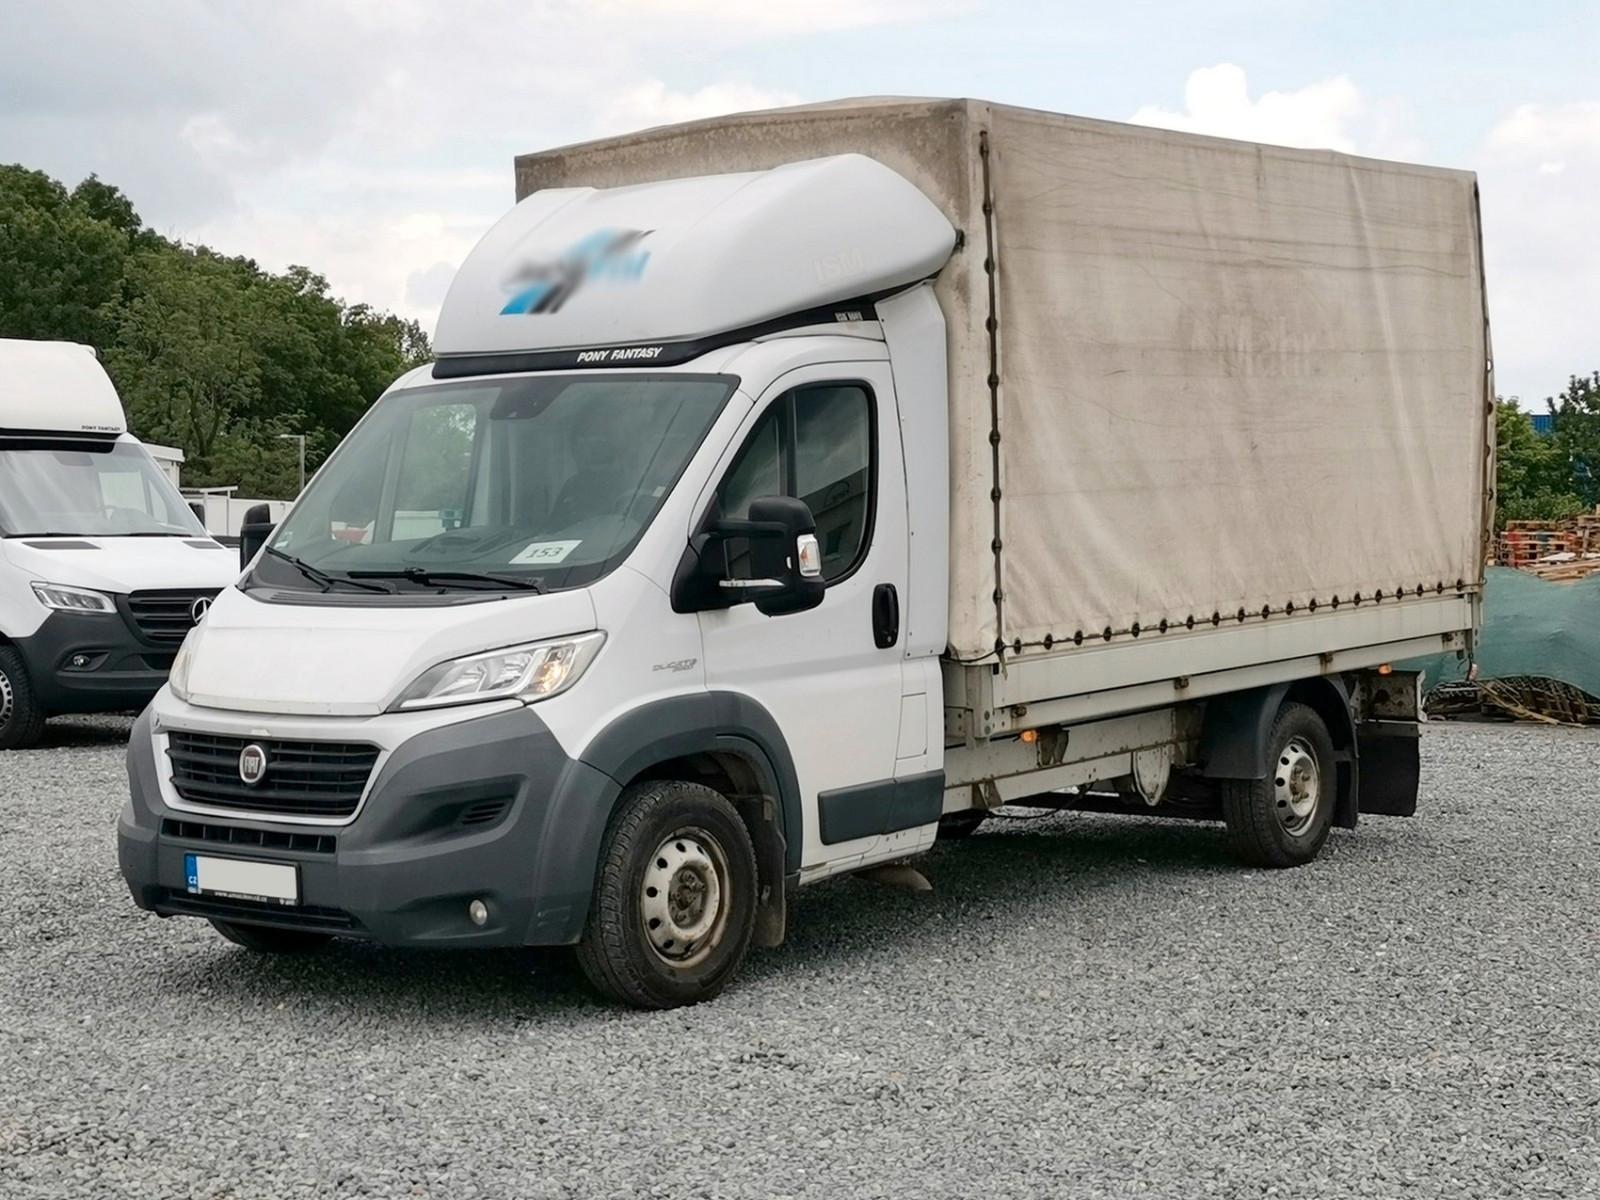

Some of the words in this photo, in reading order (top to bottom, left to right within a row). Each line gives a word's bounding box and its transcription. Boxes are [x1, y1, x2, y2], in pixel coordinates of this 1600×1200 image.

[577, 350, 610, 362] PONY
[611, 346, 663, 360] FANTASY
[525, 546, 564, 559] 153
[187, 875, 198, 885] CZ
